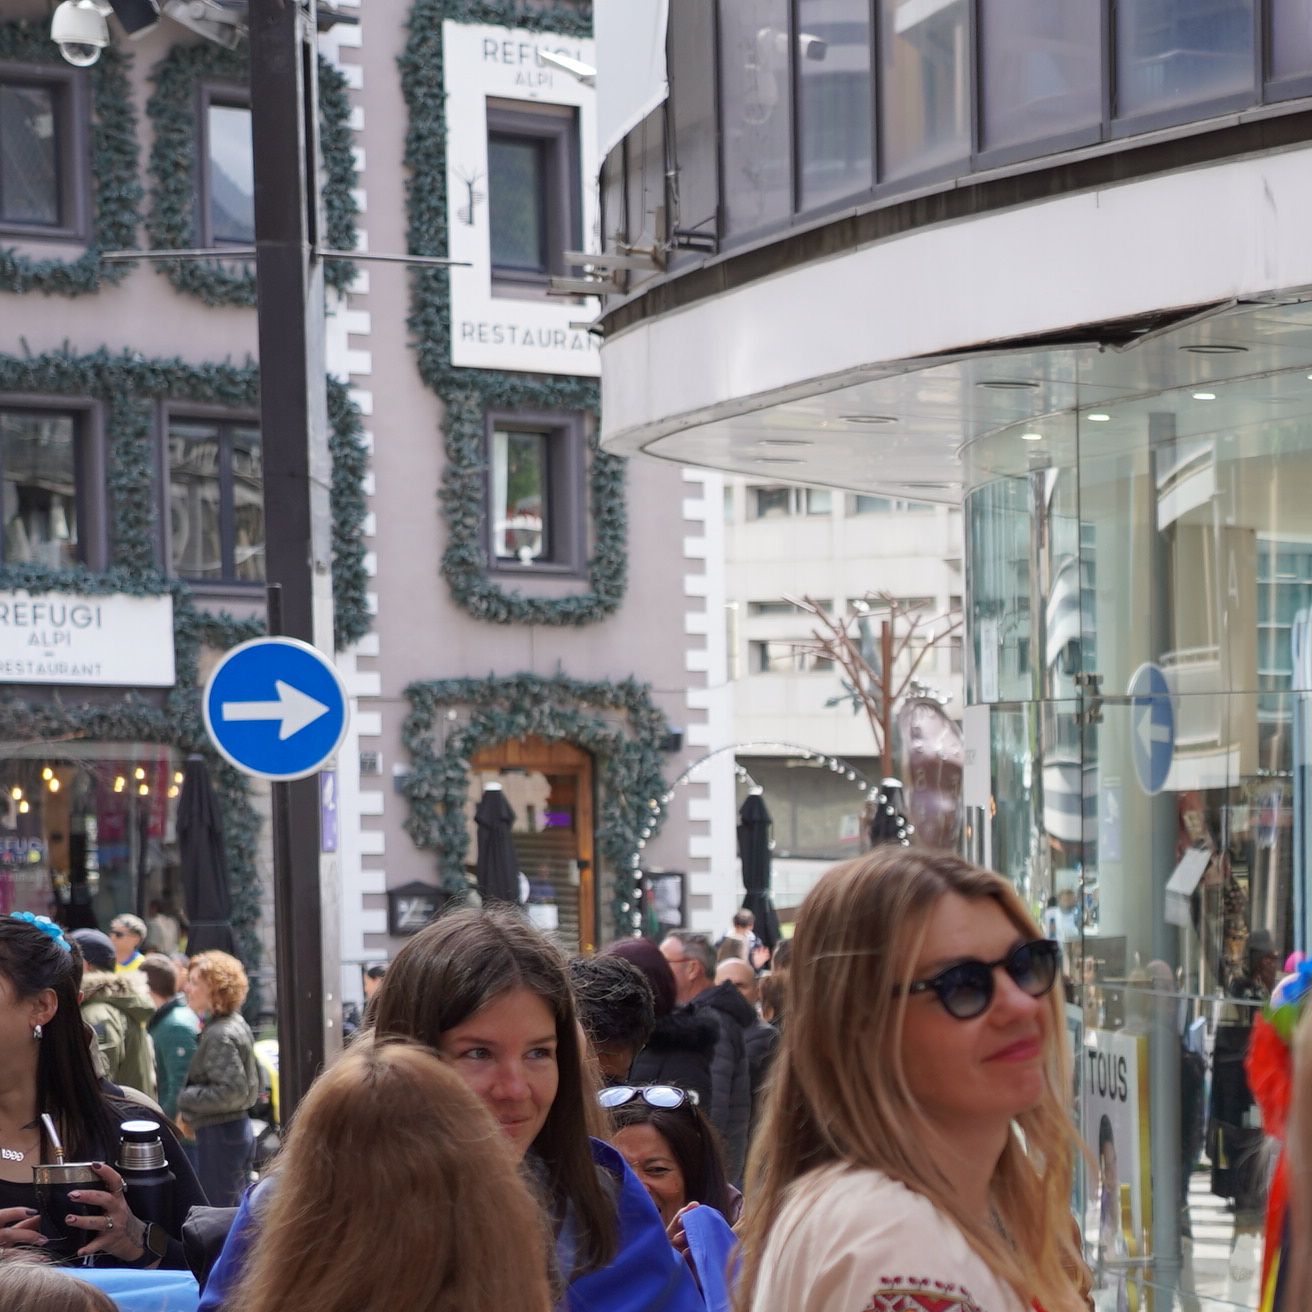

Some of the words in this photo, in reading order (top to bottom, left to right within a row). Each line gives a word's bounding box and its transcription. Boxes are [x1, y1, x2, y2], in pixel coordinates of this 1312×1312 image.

[515, 71, 554, 89] ALPI
[462, 321, 604, 351] RESTAURAN
[28, 632, 72, 647] ALPI
[1088, 1049, 1128, 1103] TOUS
